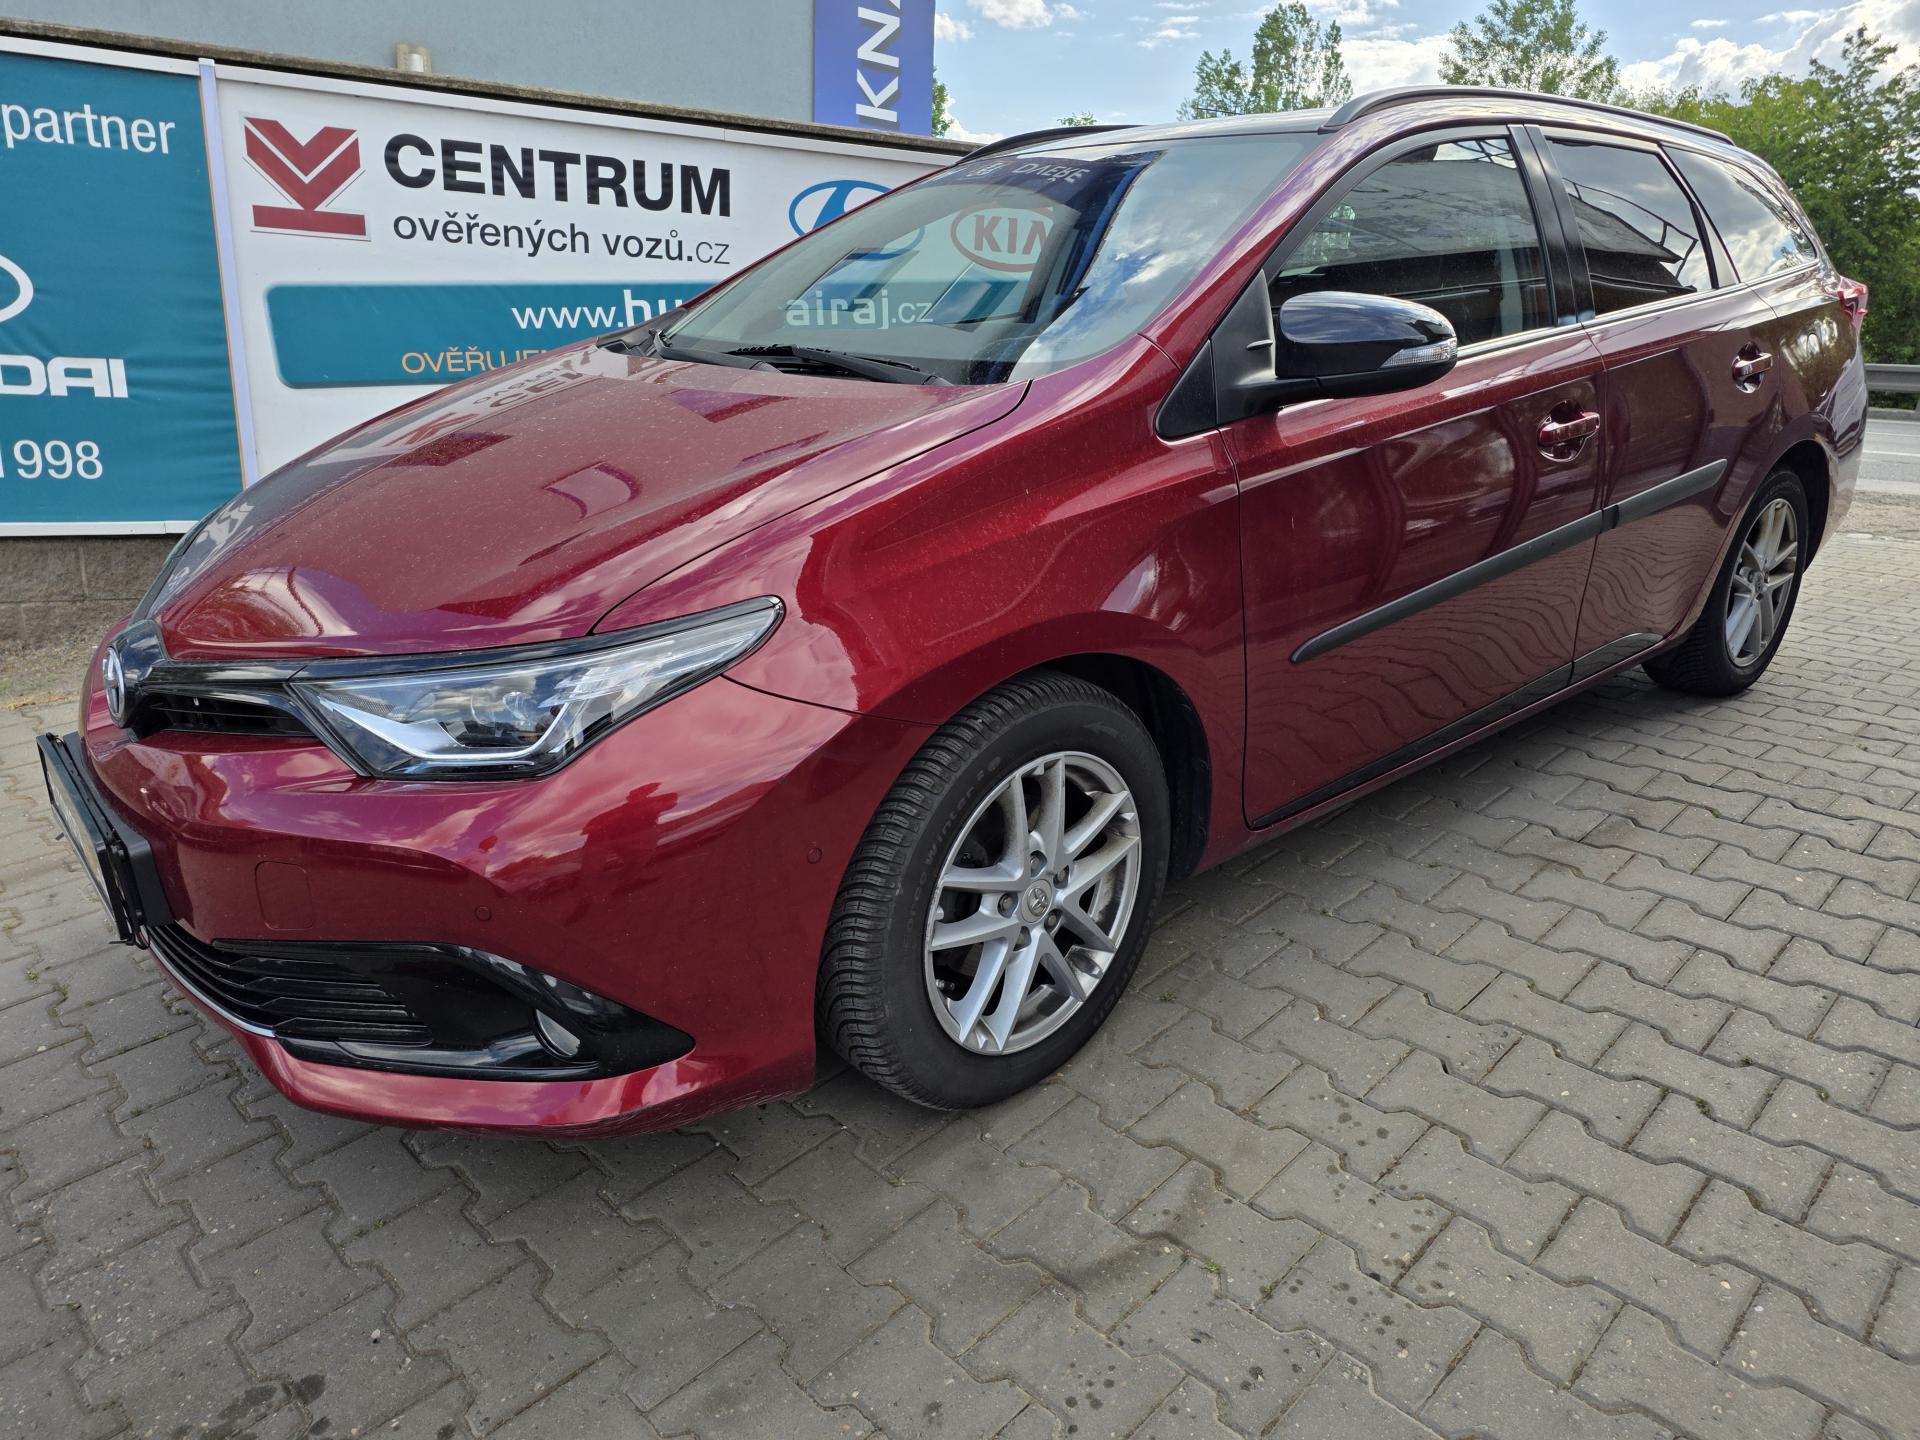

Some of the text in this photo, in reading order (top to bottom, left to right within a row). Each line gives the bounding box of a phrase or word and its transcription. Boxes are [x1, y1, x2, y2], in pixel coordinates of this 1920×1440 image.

[1, 103, 176, 154] partner
[384, 133, 731, 217] CENTRUM
[393, 211, 589, 257] ověřených
[973, 214, 1049, 256] KIA
[785, 289, 934, 330] airaj.cz
